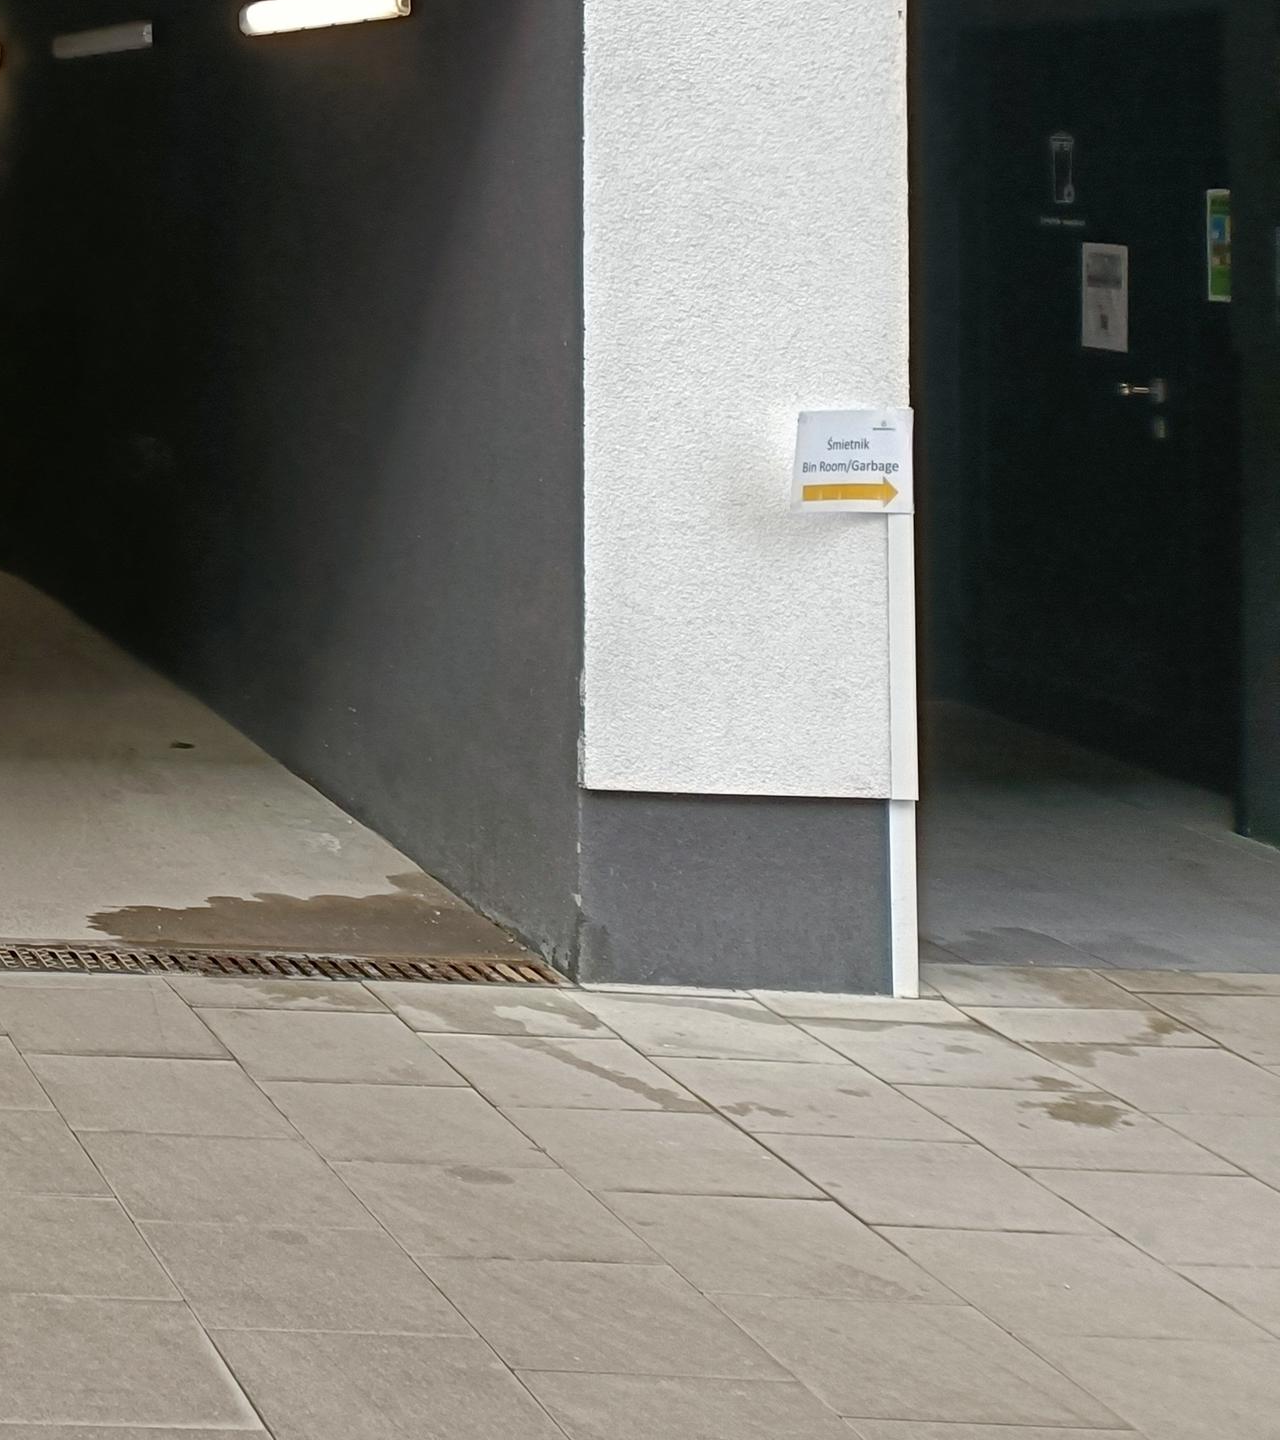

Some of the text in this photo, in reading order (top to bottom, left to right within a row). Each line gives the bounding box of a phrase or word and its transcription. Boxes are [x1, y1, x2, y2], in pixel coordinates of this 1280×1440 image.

[827, 437, 870, 451] Śmietnik
[802, 459, 899, 474] Bin Room/Garbage
